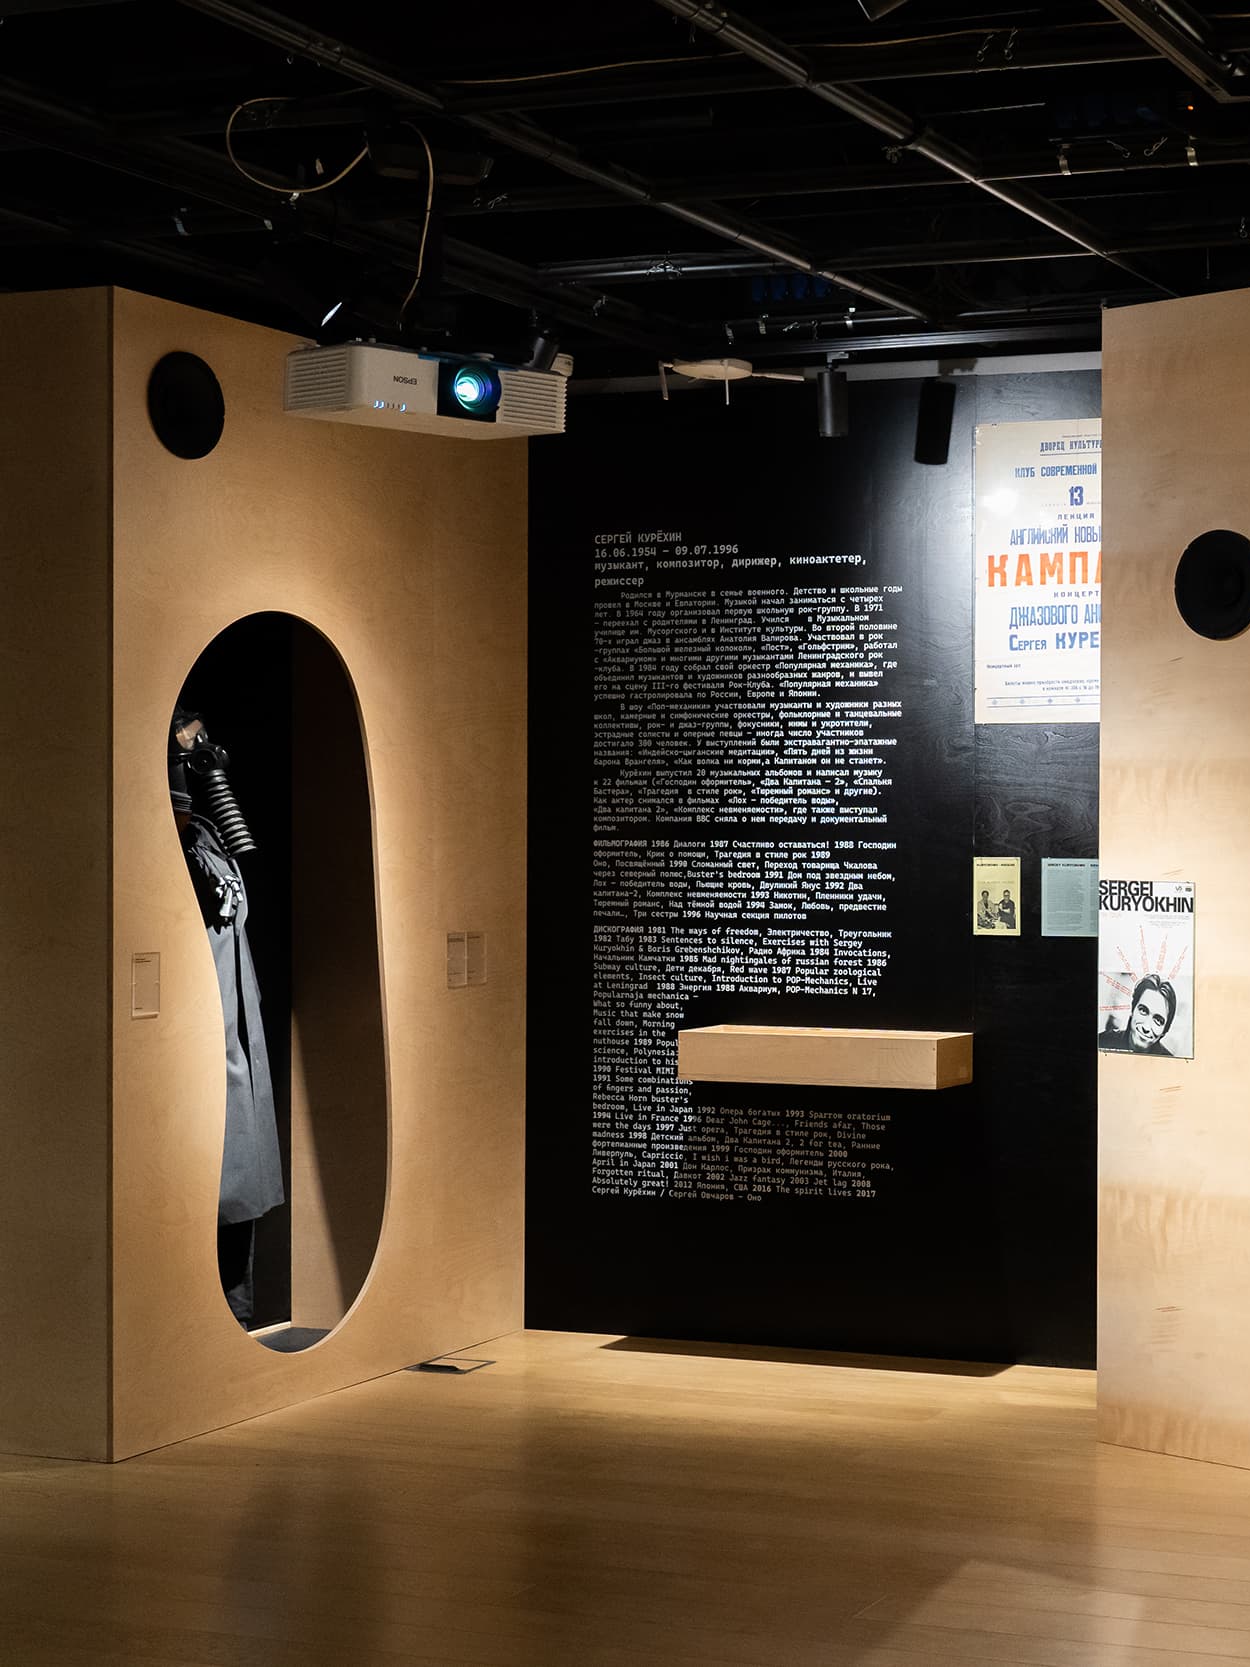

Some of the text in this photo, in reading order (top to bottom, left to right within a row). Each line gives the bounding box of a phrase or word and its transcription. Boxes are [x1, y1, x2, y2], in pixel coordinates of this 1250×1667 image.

[393, 376, 417, 385] EPSON
[1040, 441, 1065, 452] ДВОРЕЦ
[1014, 464, 1097, 478] КЛУБ СОВРЕМЕННОЙ
[1069, 486, 1084, 506] 13
[1057, 513, 1095, 521] ЛЕКЦИЯ
[594, 530, 682, 544] СЕРГЕЙ КУРЁХИН
[1010, 524, 1068, 545] АНГЛИЙСКИЙ
[594, 548, 657, 558] 16.06.1954
[675, 544, 739, 556] 09.07.1996
[594, 555, 866, 572] музыкант, композитор, дирижер, киноактетер,
[594, 576, 644, 588] режиссер
[1054, 590, 1099, 598] КОНЦЕРТ
[1009, 604, 1078, 630] ДЖАЗОВОГО
[1099, 880, 1153, 896] SERGEI
[1099, 896, 1194, 913] KURYOKHIN
[712, 927, 721, 935] of
[726, 927, 763, 938] freedom,
[768, 928, 834, 939] Электричество,
[838, 929, 892, 939] Треугольник
[720, 937, 758, 947] silence,
[762, 938, 805, 946] Exercises
[809, 938, 829, 946] with
[833, 939, 862, 948] Sergey
[748, 946, 772, 956] Радио
[777, 947, 805, 957] Африка
[810, 948, 829, 956] 1984
[833, 948, 892, 959] Invocations,
[702, 955, 716, 963] Mad
[721, 955, 777, 966] nightingales
[796, 957, 829, 965] russian
[833, 958, 863, 966] forest
[730, 965, 744, 973] Red
[772, 966, 791, 974] 1987
[795, 967, 829, 977] Popular
[833, 968, 882, 978] zoological
[711, 974, 768, 983] Introduction
[786, 976, 853, 987] POP-Mechanics,
[697, 1181, 729, 1192] Япония,
[734, 1183, 748, 1191] США
[752, 1184, 771, 1192] 2016
[776, 1185, 790, 1193] The
[794, 1186, 823, 1197] spirit
[828, 1188, 852, 1196] lives
[856, 1189, 876, 1197] 2017
[701, 1191, 734, 1202] Овчаров
[747, 1193, 762, 1201] Оно
